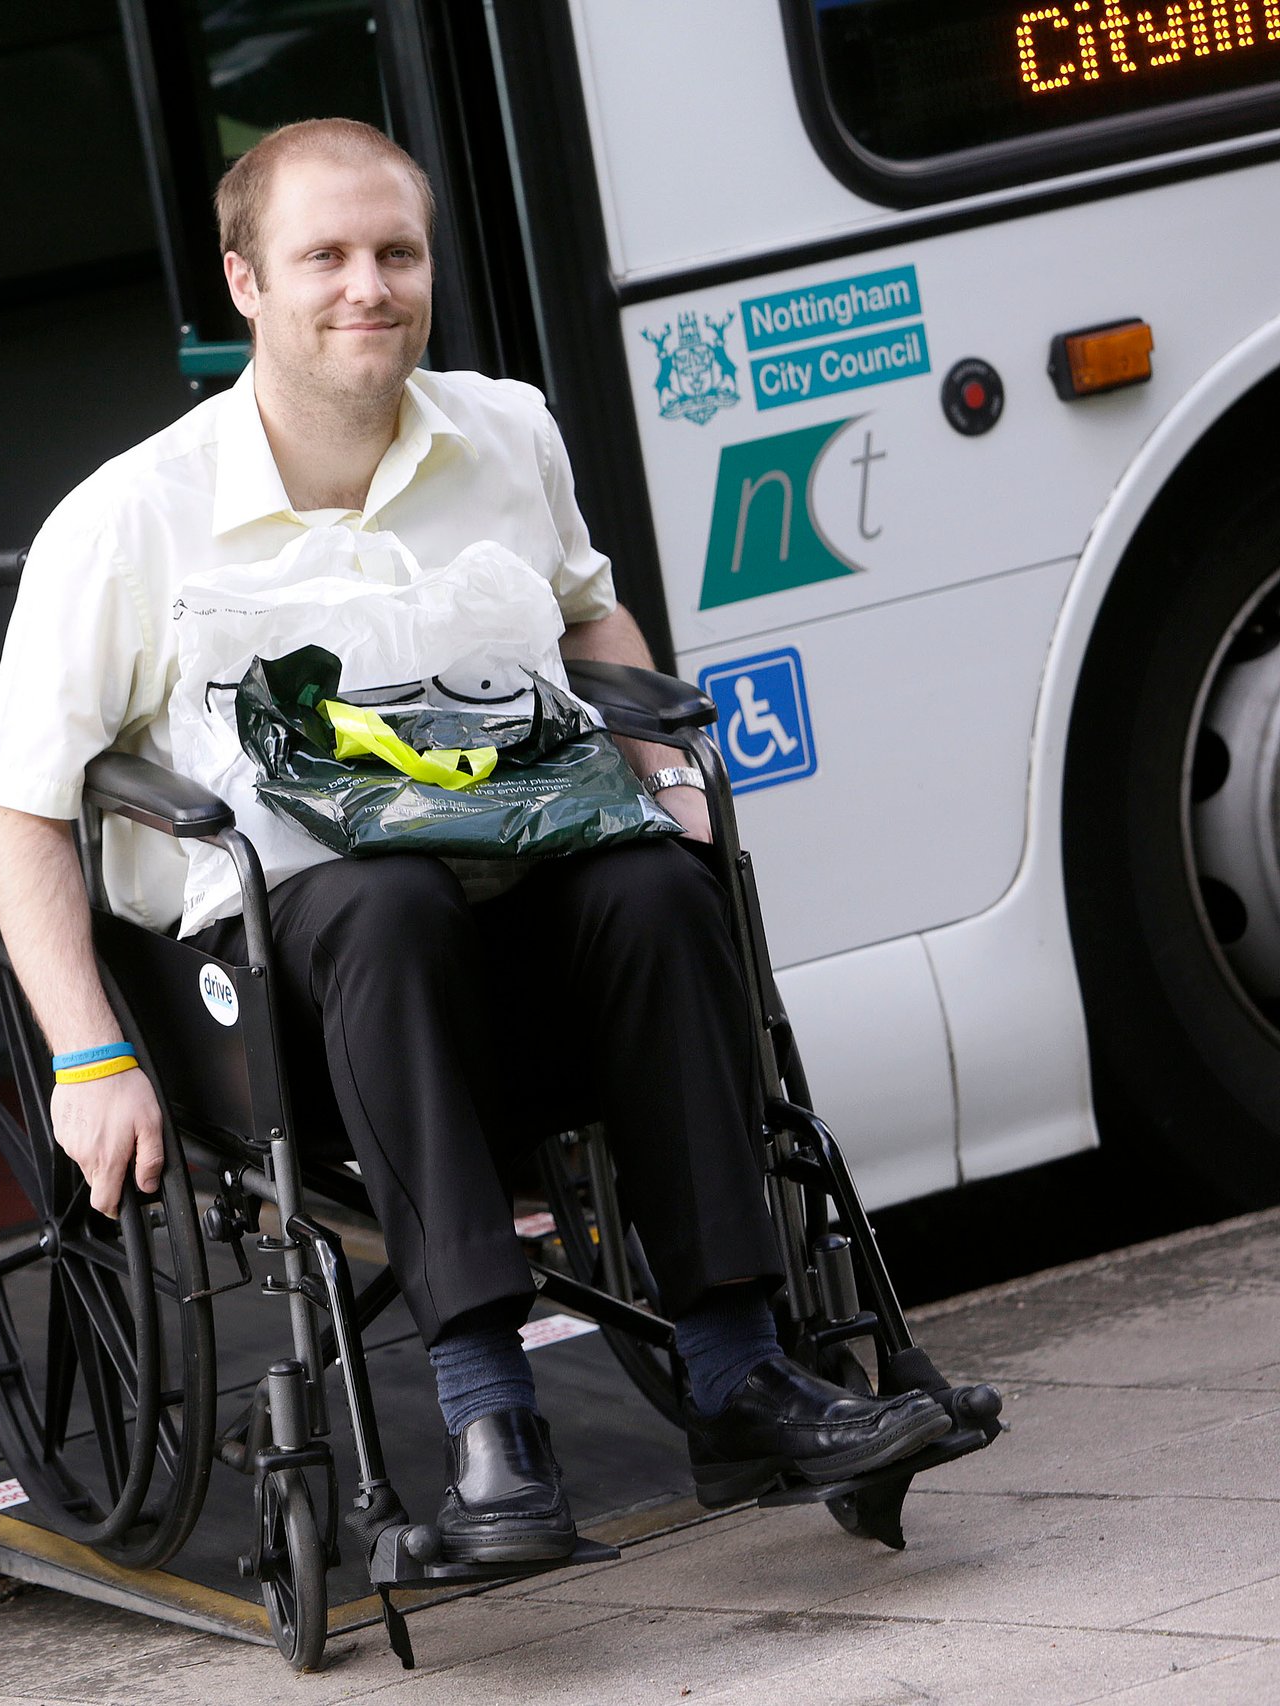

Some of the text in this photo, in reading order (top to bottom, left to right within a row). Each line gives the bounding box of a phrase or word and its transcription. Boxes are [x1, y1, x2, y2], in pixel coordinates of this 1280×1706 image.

[750, 279, 911, 337] Nottingham
[759, 360, 813, 396] City
[819, 331, 921, 383] Council
[474, 788, 495, 796] the
[497, 782, 572, 795] environment
[204, 972, 233, 1005] drive
